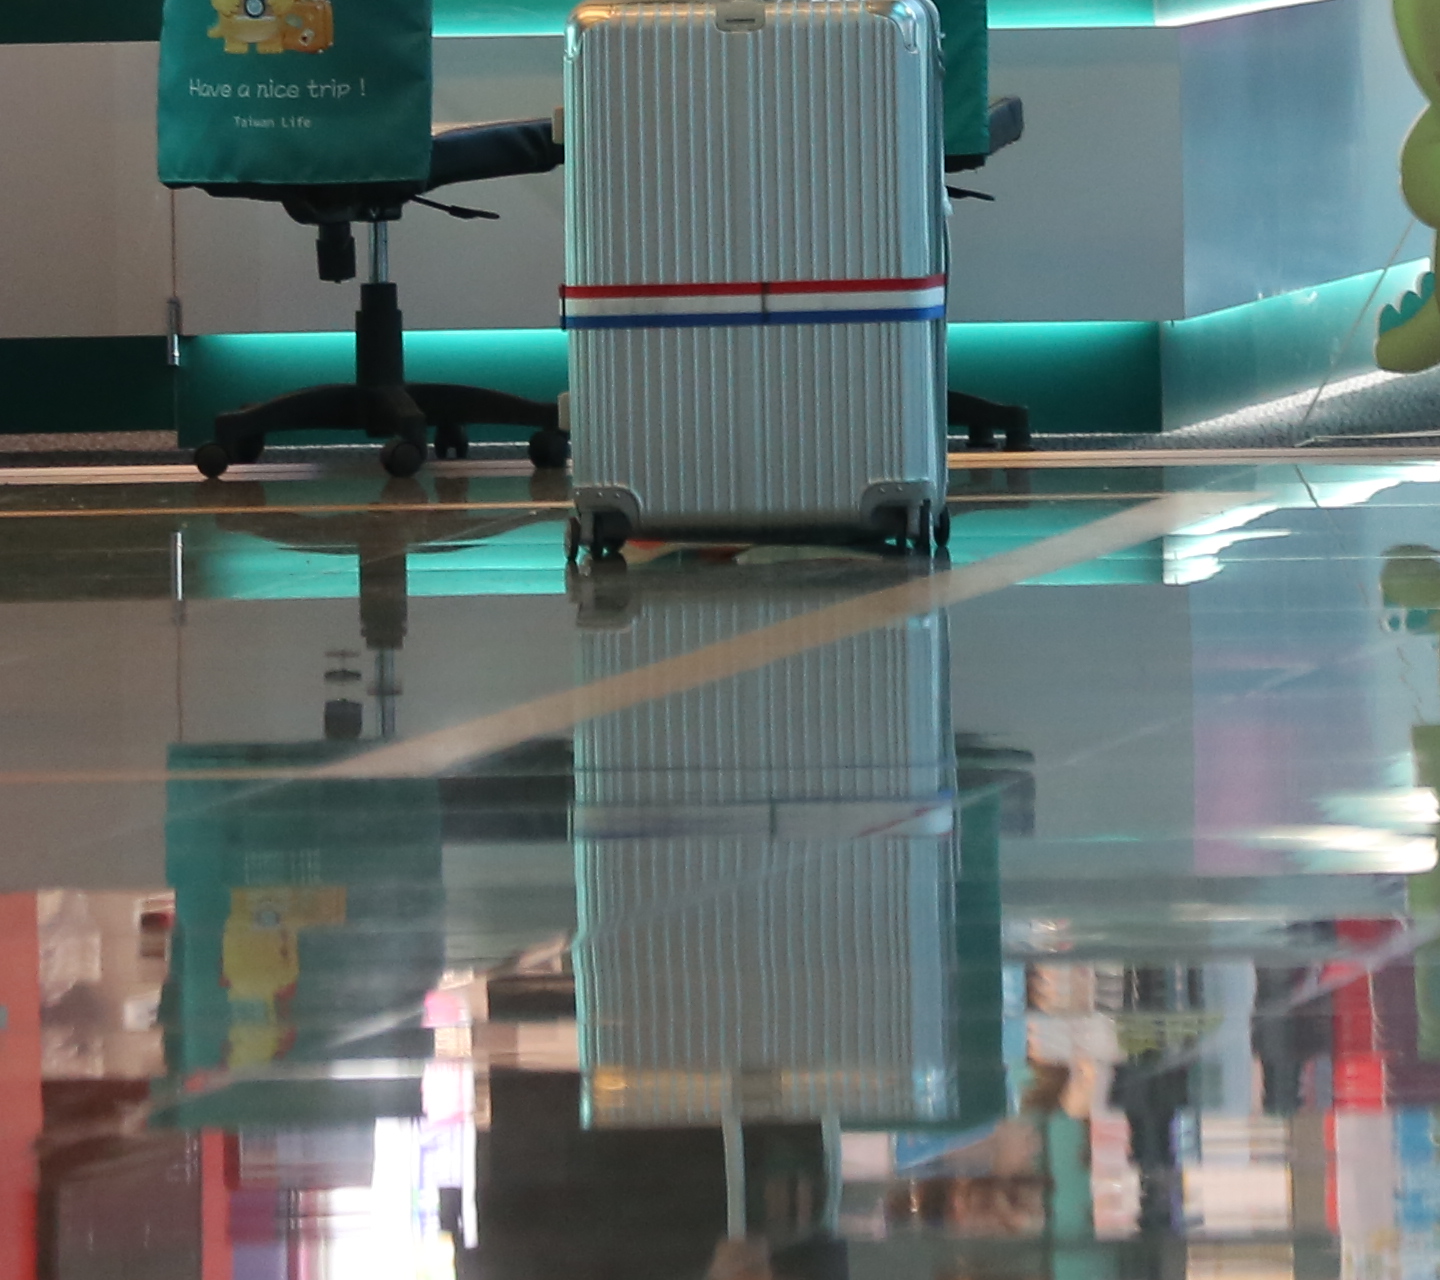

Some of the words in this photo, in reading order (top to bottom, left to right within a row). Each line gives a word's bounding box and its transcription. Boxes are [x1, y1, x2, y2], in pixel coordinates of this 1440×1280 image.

[189, 78, 232, 97] Have
[237, 84, 250, 98] a
[257, 79, 299, 98] nice
[307, 79, 351, 99] trip
[233, 116, 274, 128] Taiwan
[281, 116, 311, 128] Life
